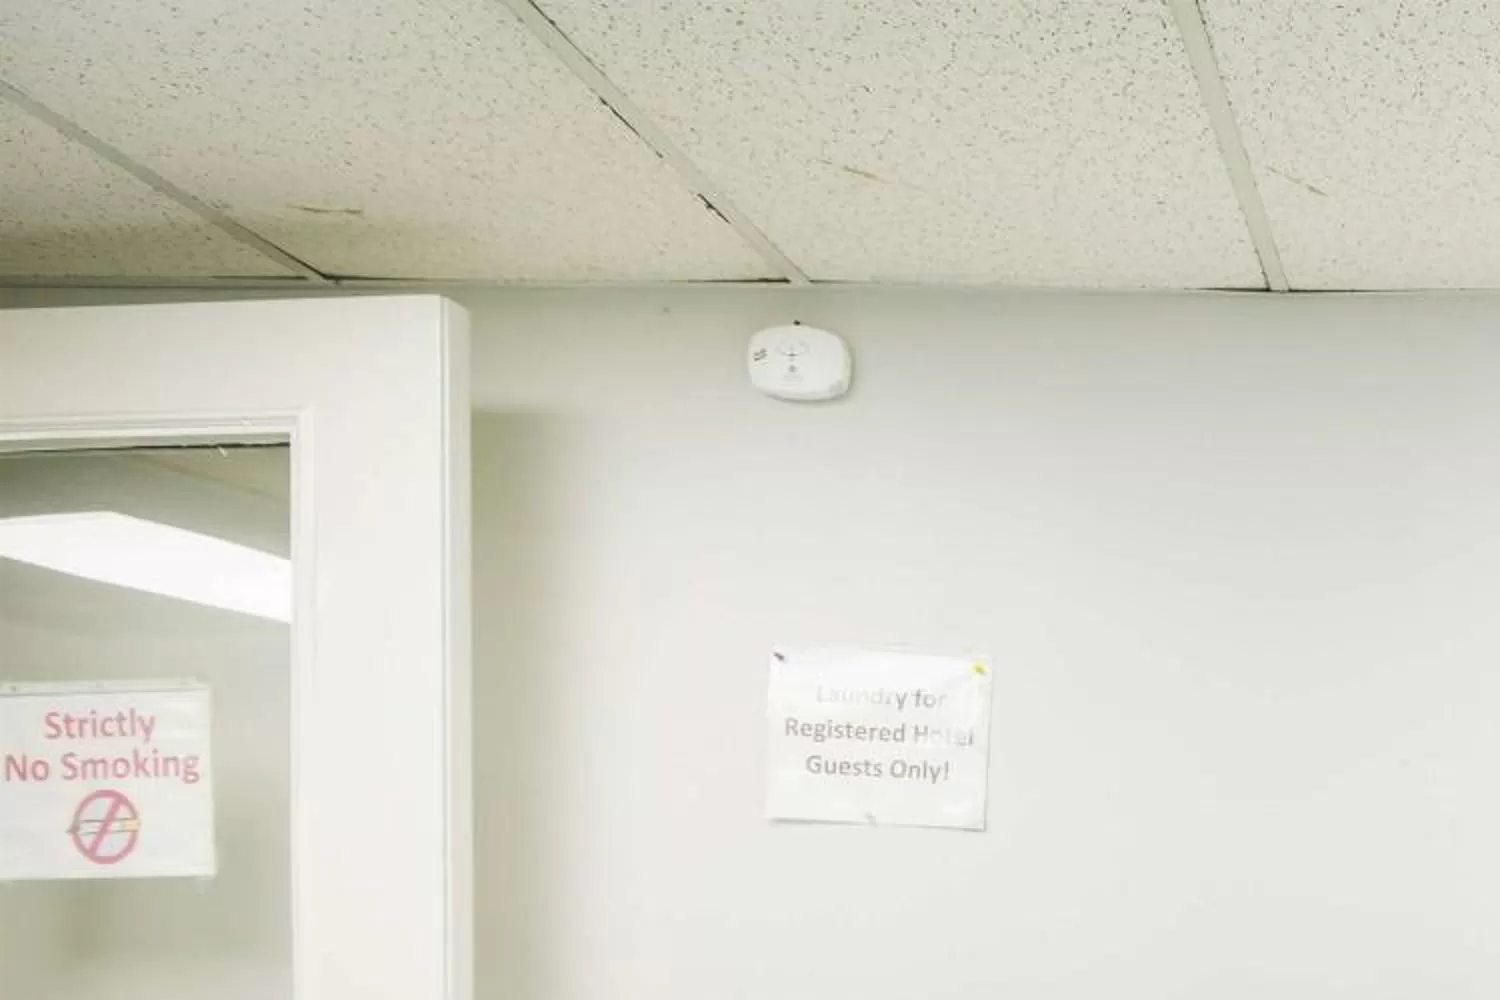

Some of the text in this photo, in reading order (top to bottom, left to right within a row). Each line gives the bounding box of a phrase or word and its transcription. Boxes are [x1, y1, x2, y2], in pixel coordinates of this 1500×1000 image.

[912, 687, 948, 709] for
[43, 707, 156, 743] Strictly
[785, 717, 975, 748] Registered Hel
[4, 747, 201, 784] No Smoking
[805, 754, 950, 784] Guests Only!
